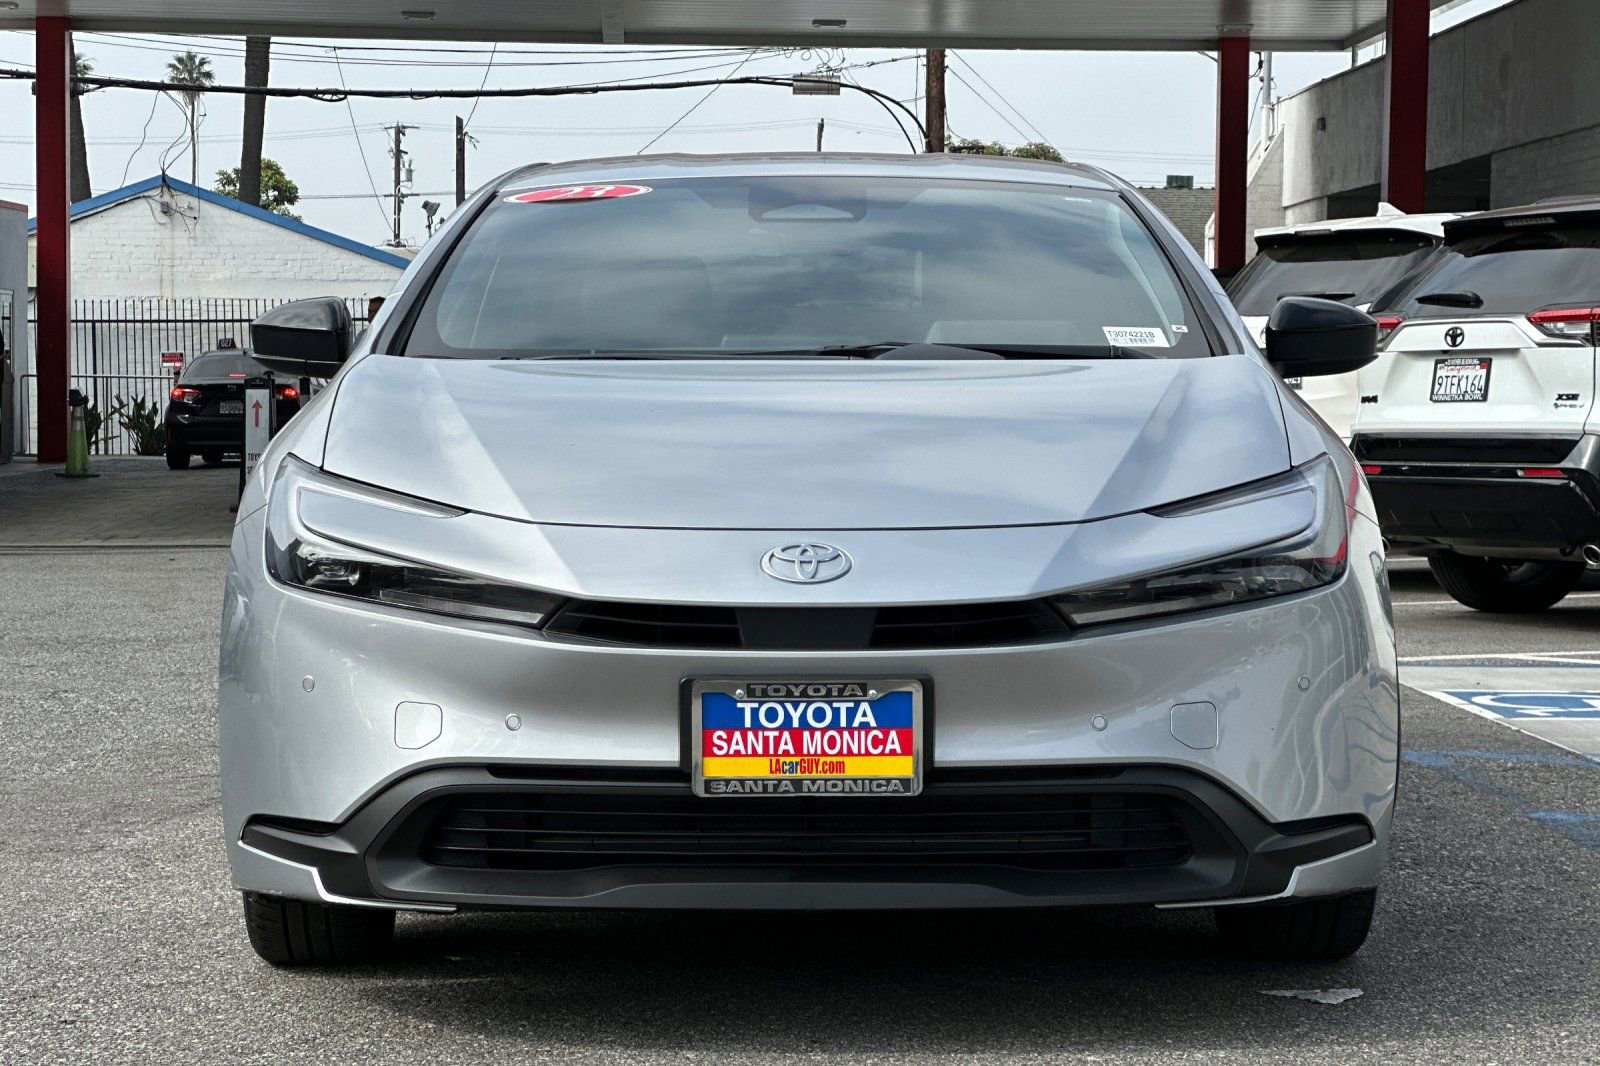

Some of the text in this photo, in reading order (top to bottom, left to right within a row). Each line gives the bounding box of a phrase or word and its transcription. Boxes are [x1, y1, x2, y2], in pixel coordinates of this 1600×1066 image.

[1436, 374, 1483, 394] 9TFK164
[1432, 392, 1483, 401] WINNETKA BOWL
[750, 684, 863, 697] TOYOTA
[737, 702, 877, 728] TOYOTA
[712, 730, 902, 755] SANTA MONICA
[769, 758, 845, 775] LAcarGUY.com
[710, 779, 905, 793] SANTA MONICA
